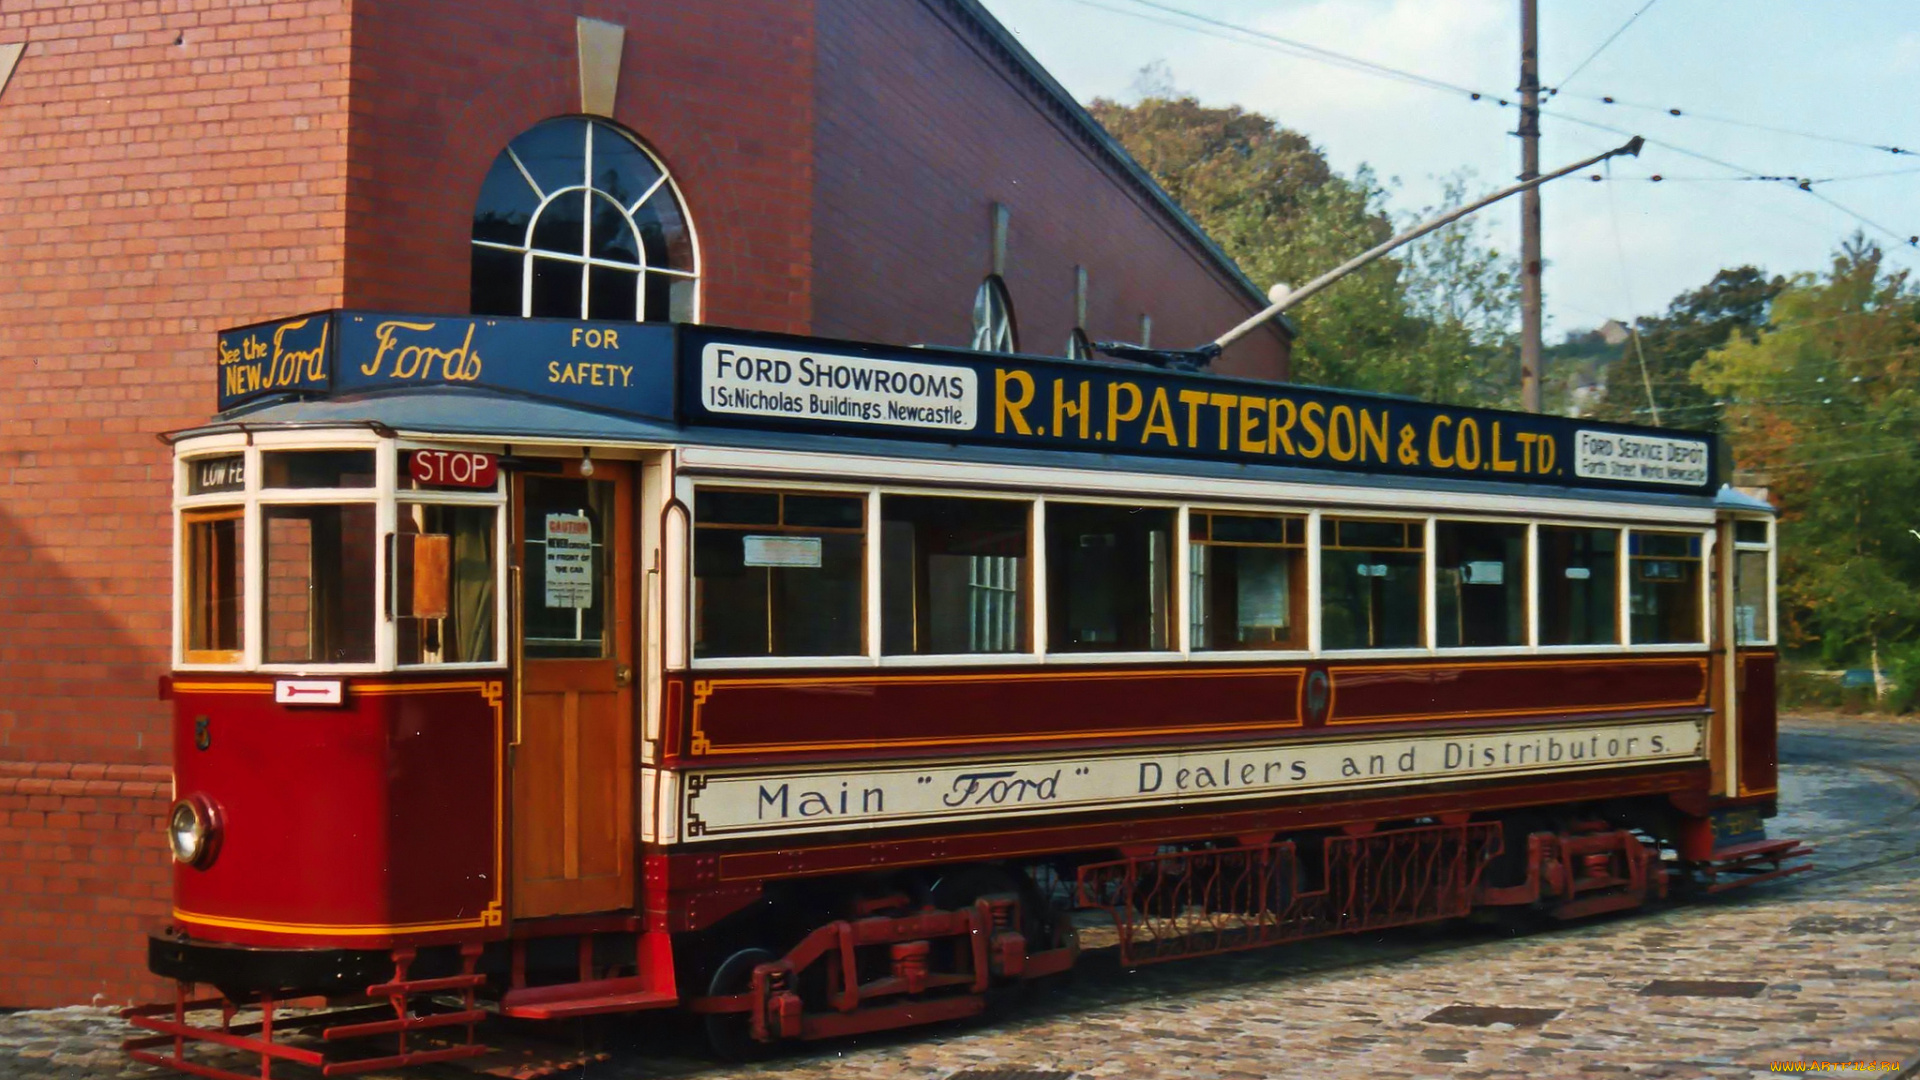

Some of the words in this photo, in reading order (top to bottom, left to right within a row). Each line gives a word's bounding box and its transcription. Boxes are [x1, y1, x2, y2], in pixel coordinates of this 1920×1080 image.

[220, 340, 241, 366] See
[242, 333, 268, 361] the
[571, 327, 620, 350] FOR
[226, 362, 262, 397] NEW
[548, 361, 635, 388] SAFETY.
[717, 349, 792, 385] FORD
[797, 357, 965, 401] SHOWROOMS
[1398, 423, 1420, 466] &
[1583, 433, 1613, 456] FORD
[1618, 438, 1663, 461] SERVICE
[1667, 442, 1704, 464] DEPOT
[202, 462, 226, 487] LOW
[416, 450, 490, 483] STOP
[548, 538, 568, 548] NEVER
[549, 521, 588, 533] CAUTION
[758, 781, 884, 820] Main
[1138, 757, 1307, 794] Dealers
[1341, 746, 1416, 777] and
